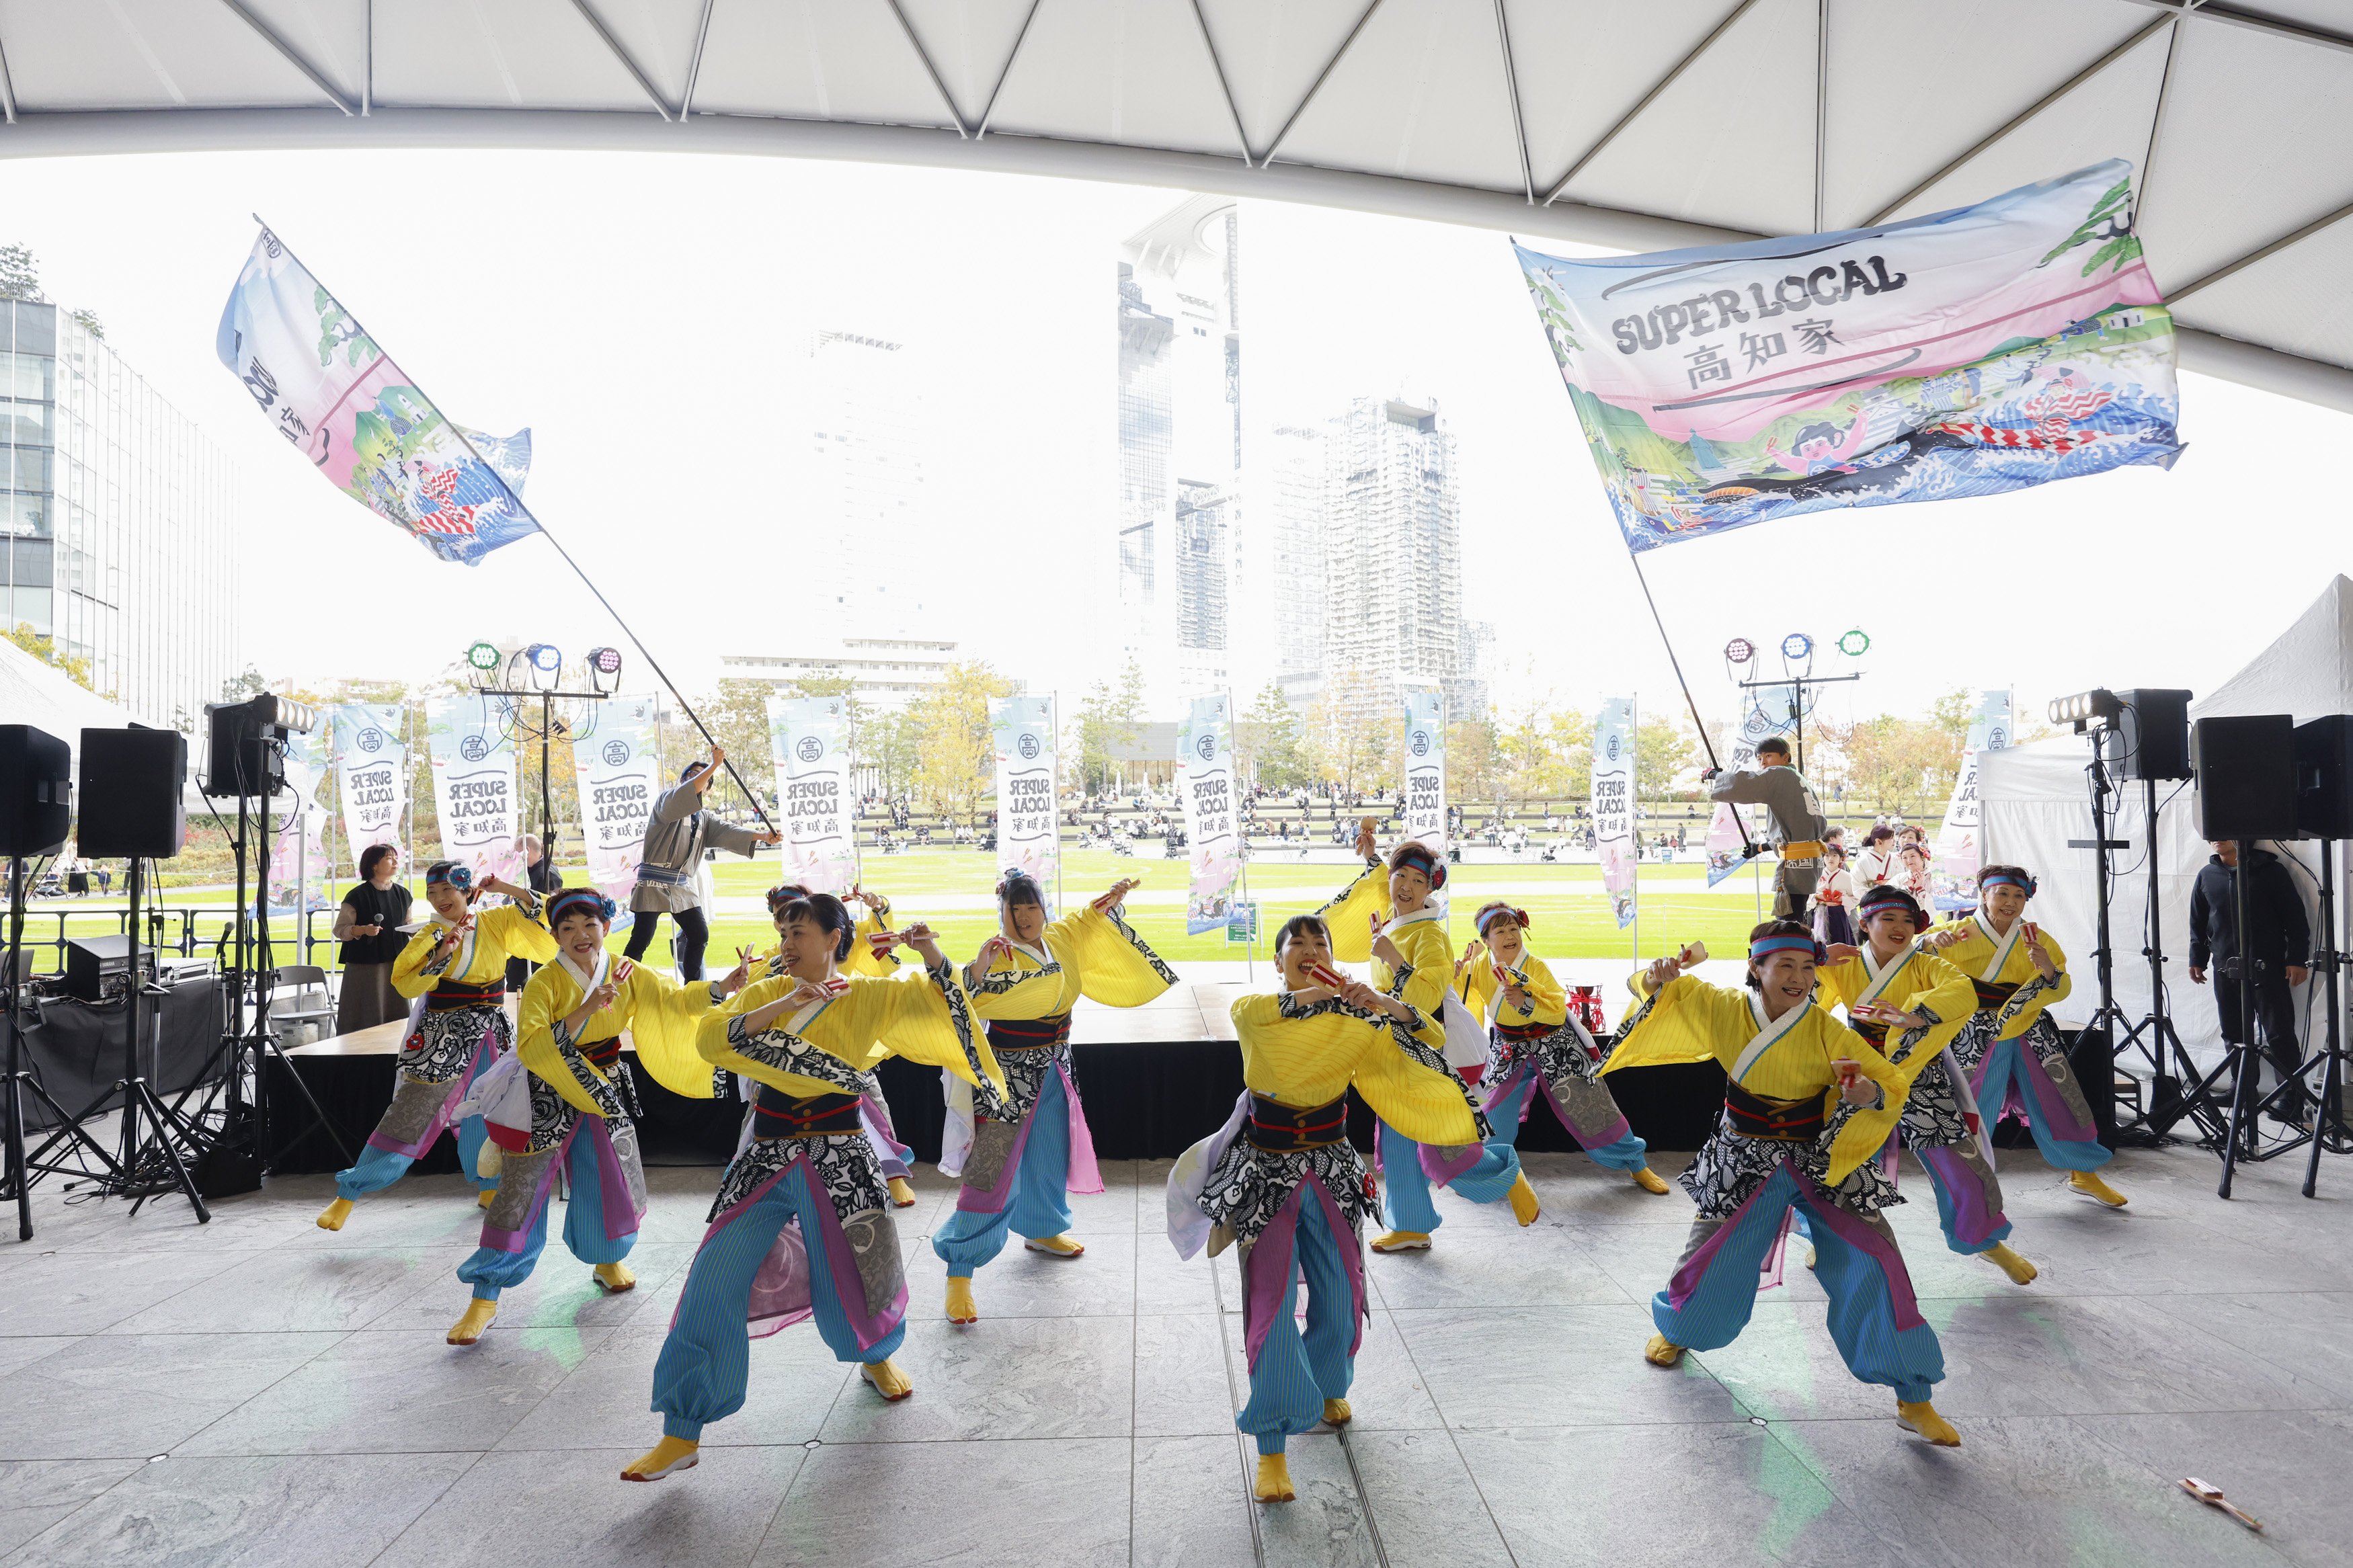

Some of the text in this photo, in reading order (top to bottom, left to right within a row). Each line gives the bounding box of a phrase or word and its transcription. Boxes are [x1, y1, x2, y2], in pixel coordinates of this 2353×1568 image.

[1613, 255, 1908, 355] SUPER LOCAL
[1683, 318, 1845, 390] 高知家
